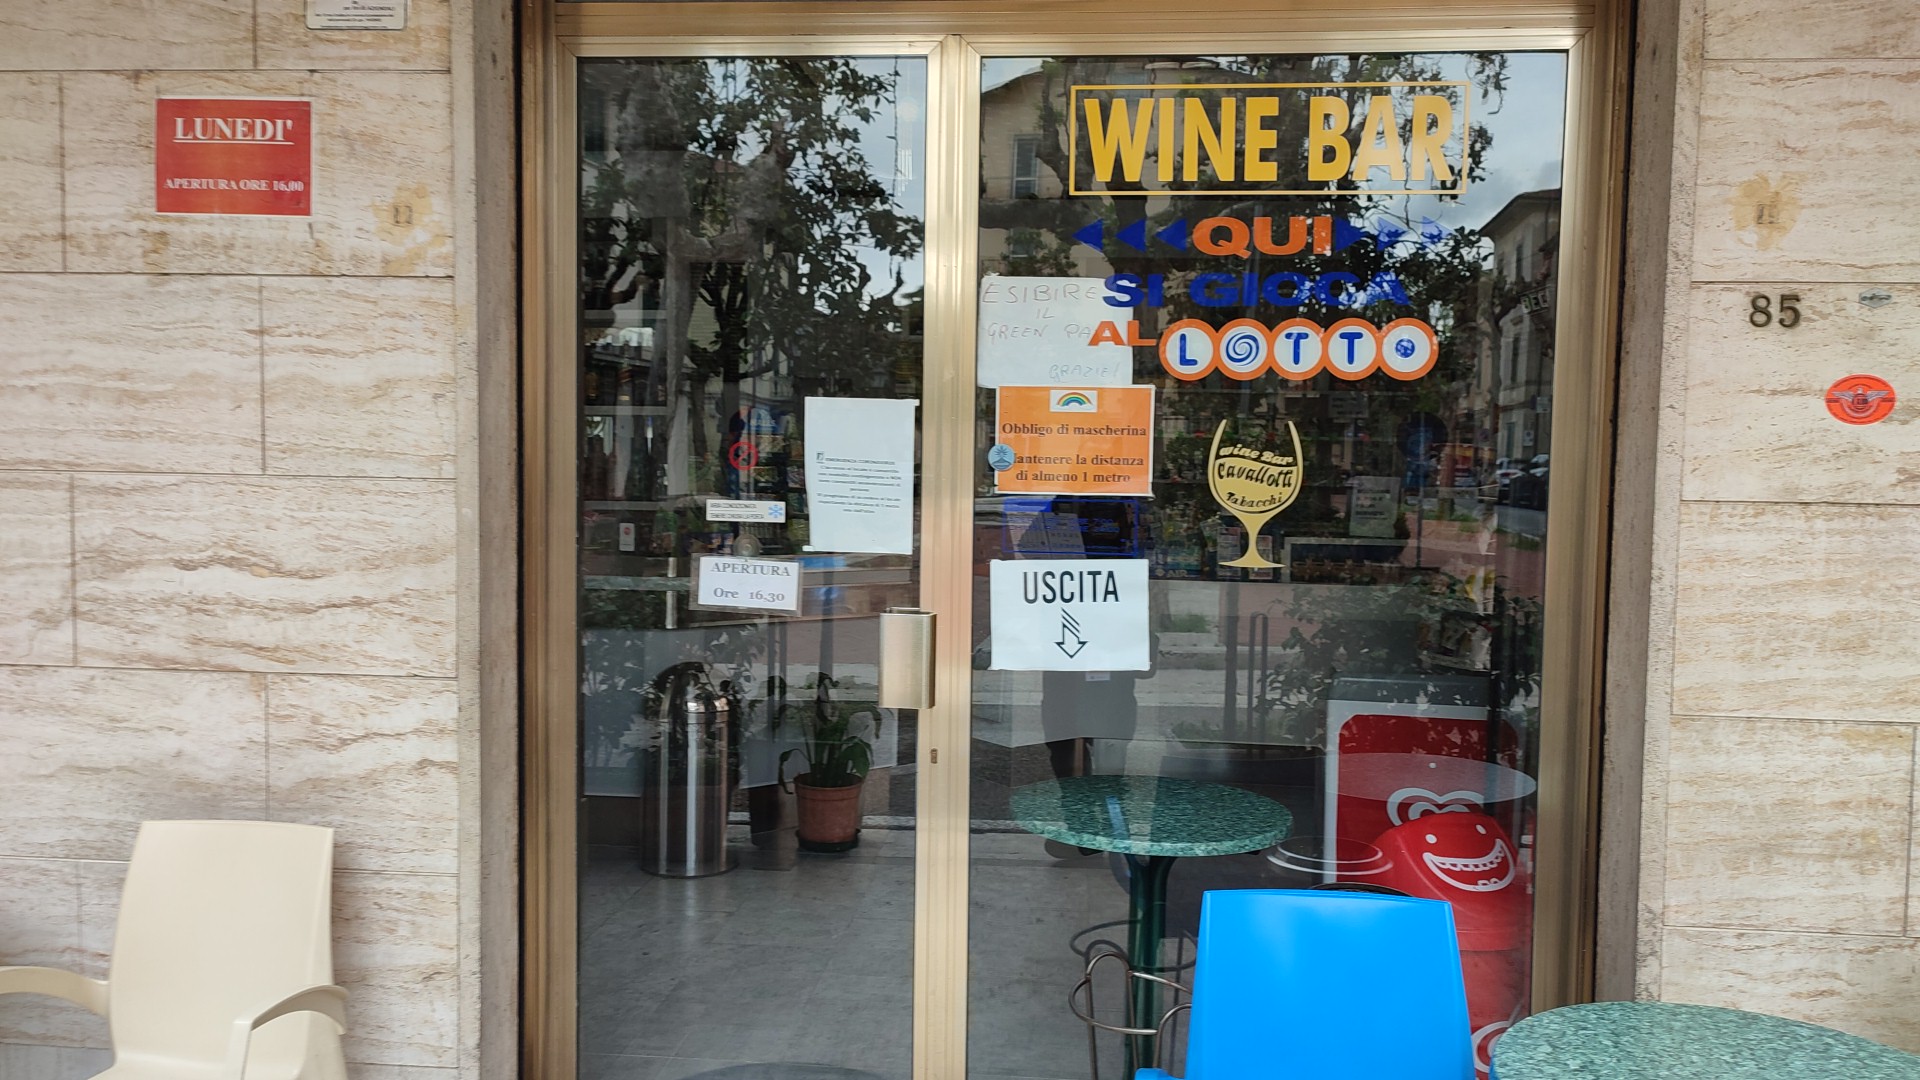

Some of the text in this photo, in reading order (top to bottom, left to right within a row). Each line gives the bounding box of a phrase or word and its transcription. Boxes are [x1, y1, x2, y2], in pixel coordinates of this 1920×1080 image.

[174, 117, 294, 141] LUNEDI'
[1083, 95, 1455, 182] WINE BAR
[163, 178, 239, 191] APERTURA
[239, 179, 271, 191] ORE
[1192, 215, 1332, 259] QUI
[981, 281, 1097, 304] ESIBIRE
[1102, 271, 1411, 308] SI GIOCA
[1036, 307, 1056, 320] IL
[1749, 294, 1801, 328] 85
[987, 322, 1049, 342] GREEN
[1087, 319, 1419, 370] AL LOTTO
[1002, 423, 1147, 438] Obbligo di mascherina
[1076, 453, 1088, 465] la
[1091, 453, 1145, 466] distanza
[1218, 444, 1294, 466] wine Bar
[1016, 470, 1131, 483] di almeno 1 metro
[1217, 461, 1294, 489] Cavallotti
[1225, 491, 1284, 508] Tabacchi
[710, 562, 792, 577] APERTURA
[713, 587, 740, 599] Ore
[1022, 570, 1120, 604] USCITA
